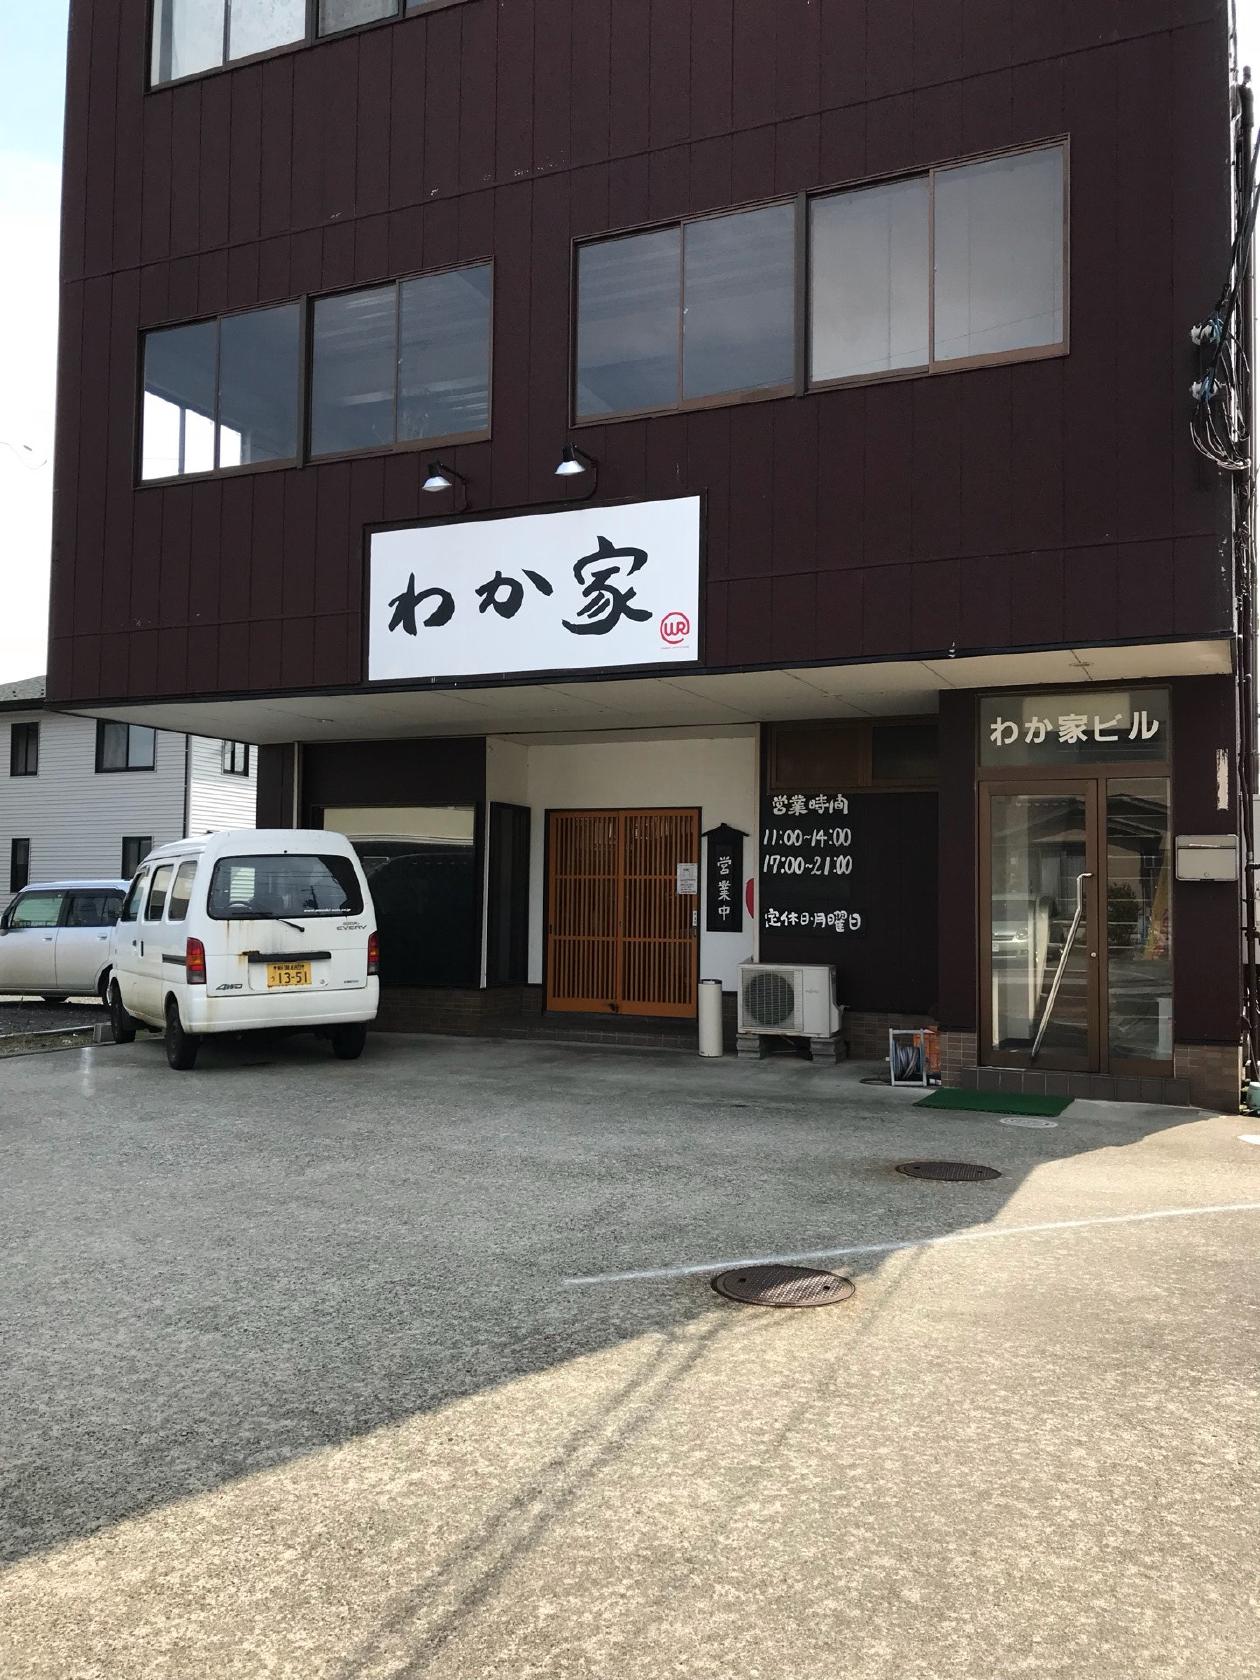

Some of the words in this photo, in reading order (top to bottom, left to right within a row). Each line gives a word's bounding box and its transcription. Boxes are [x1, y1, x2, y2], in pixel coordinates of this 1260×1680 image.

[388, 535, 653, 636] わか家
[990, 711, 1160, 746] わか家ビル
[772, 793, 849, 816] 営業時間
[717, 855, 732, 921] 営業中
[215, 983, 243, 991] 4WD
[278, 971, 307, 984] 13-51
